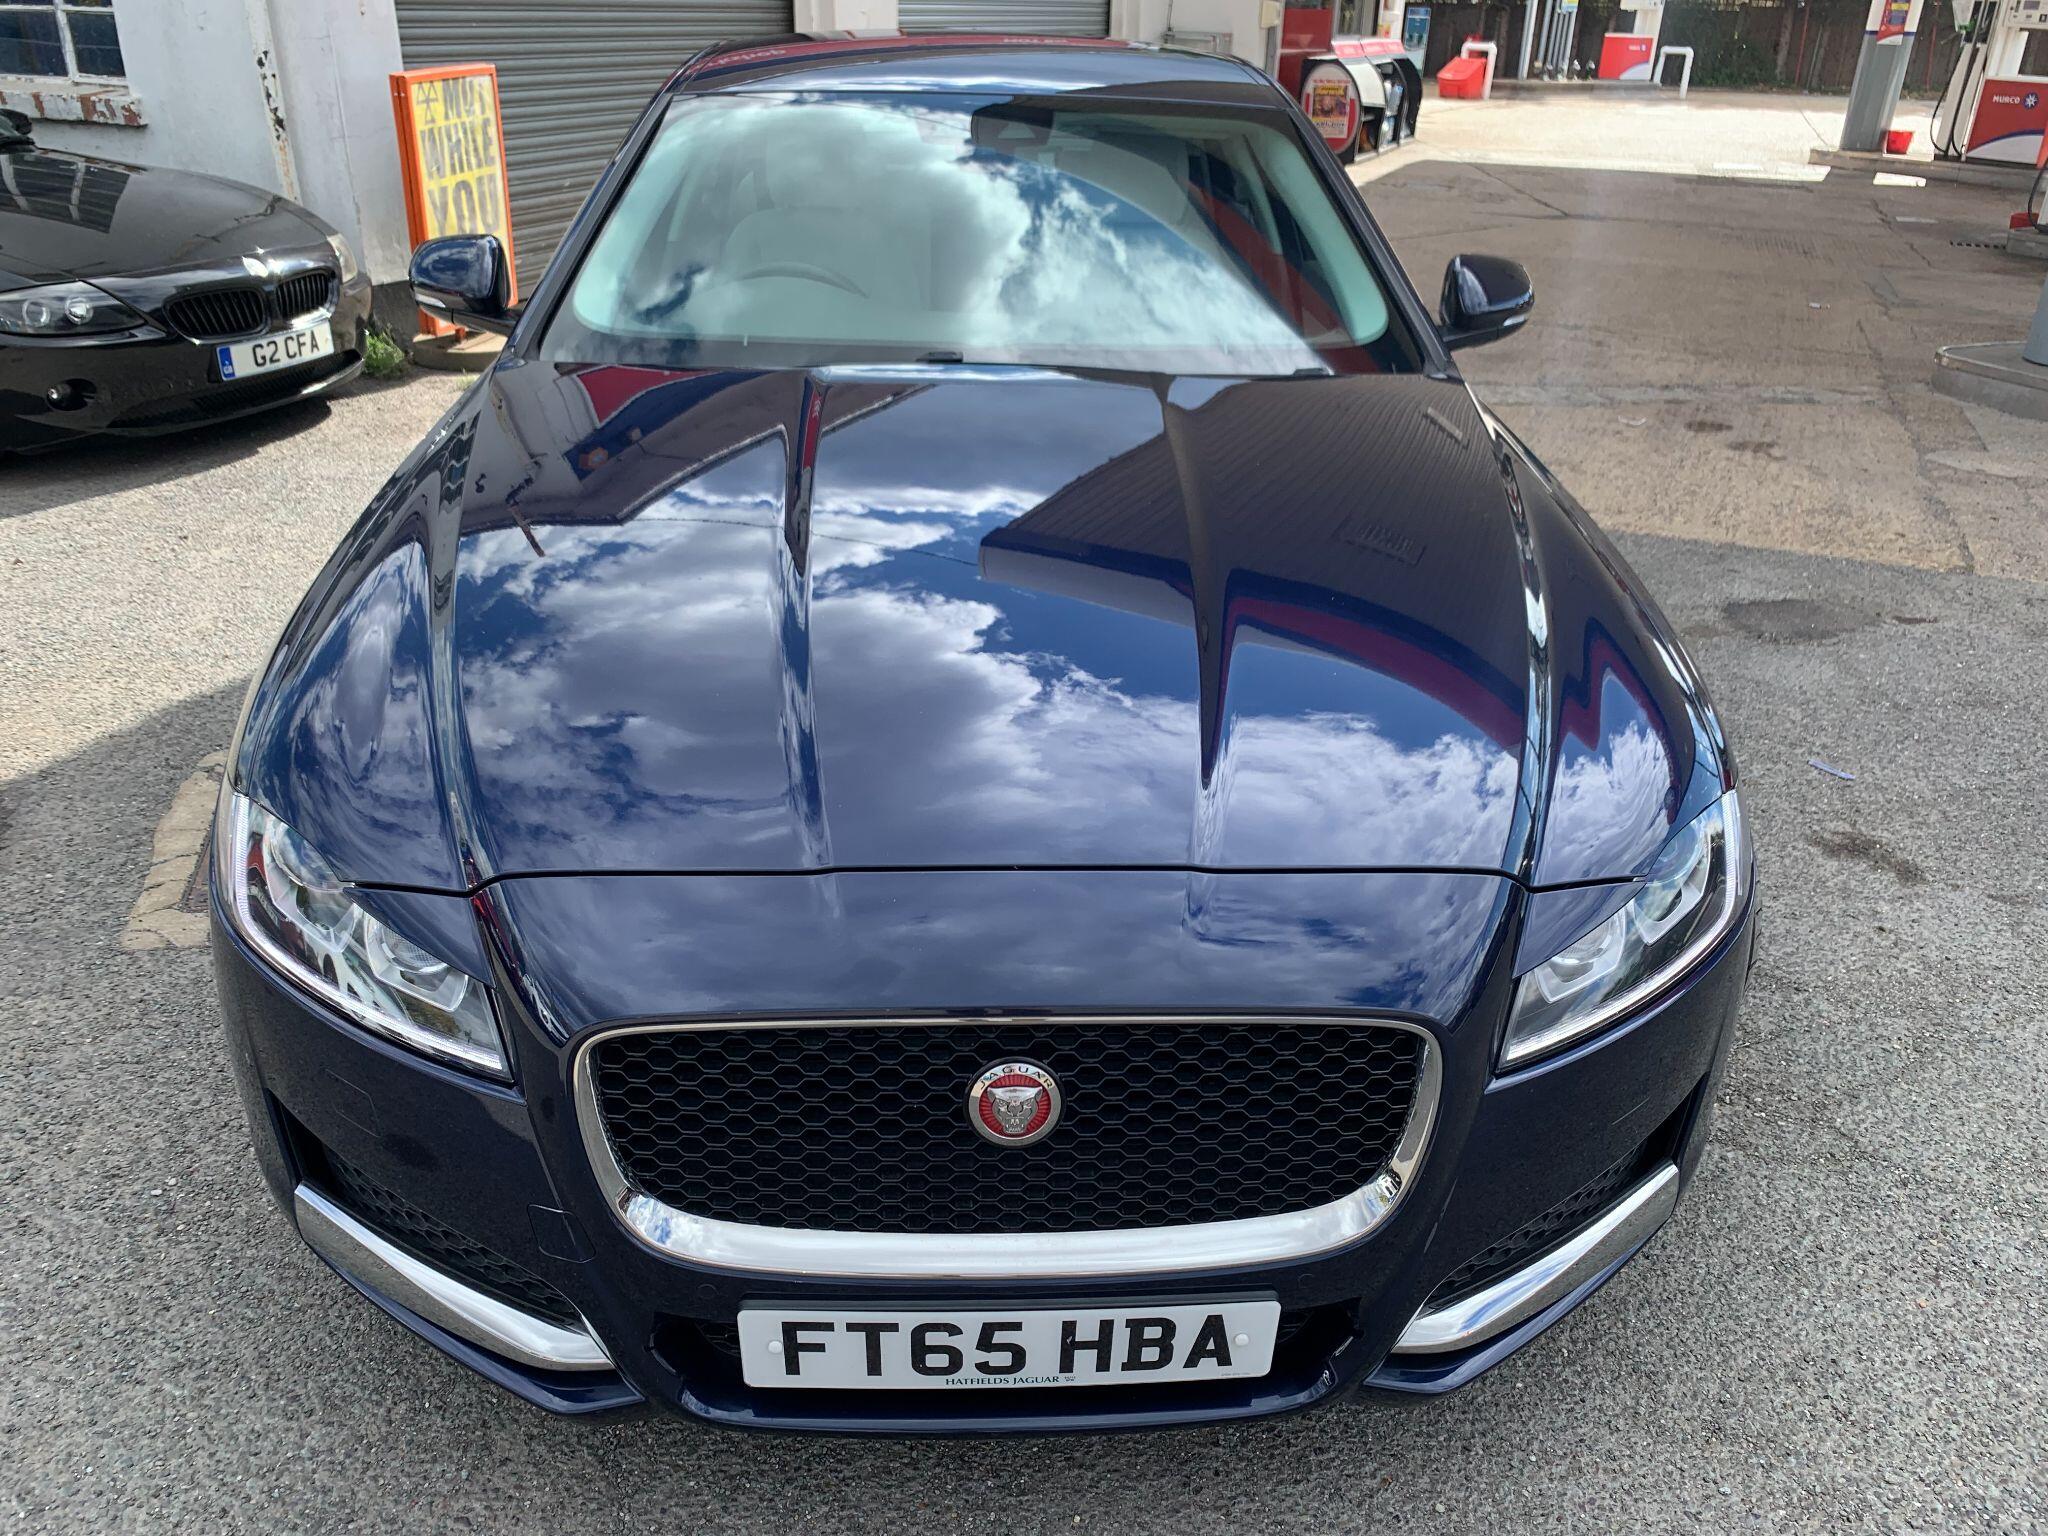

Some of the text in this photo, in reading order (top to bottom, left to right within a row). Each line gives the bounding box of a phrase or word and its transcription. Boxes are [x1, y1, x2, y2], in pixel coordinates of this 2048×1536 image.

[1992, 95, 2020, 104] MURCO
[420, 117, 496, 180] WHILE
[427, 174, 501, 237] YOU
[252, 330, 320, 368] G2 CFA
[980, 1065, 1053, 1090] JAGUAR
[781, 1315, 1232, 1376] FT65 HBA
[945, 1377, 1010, 1386] HATFIELDS
[1012, 1376, 1060, 1385] JAGUAR
